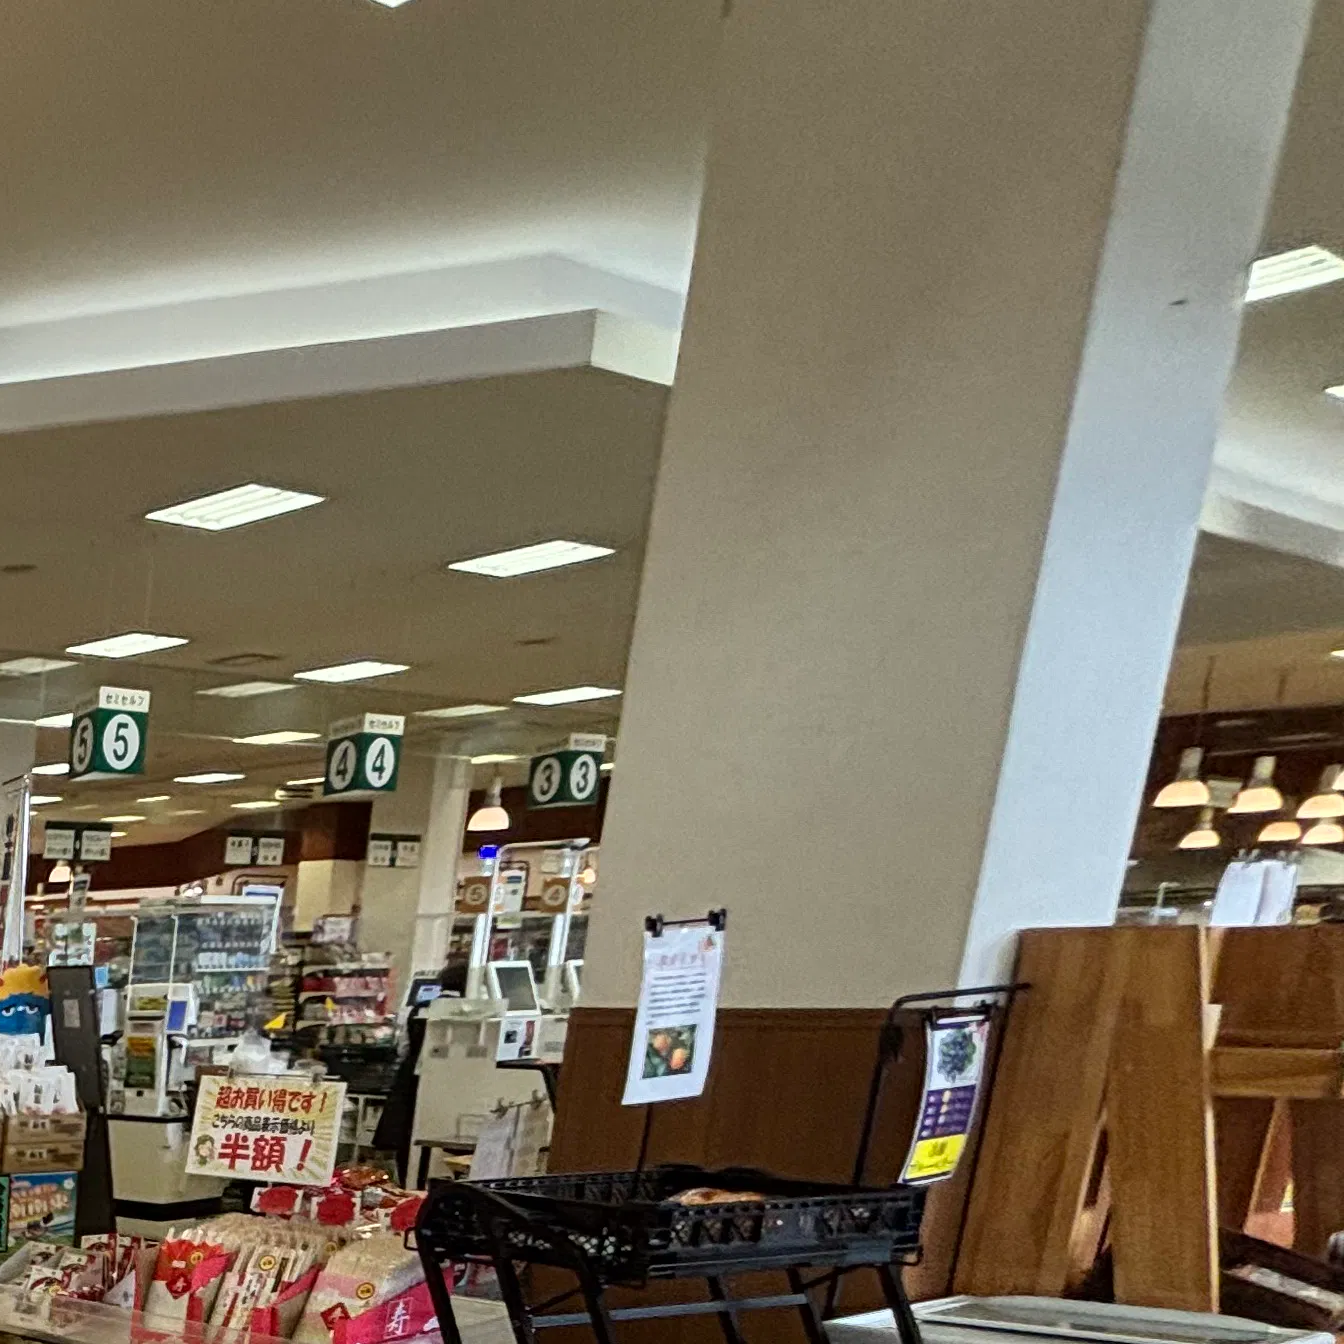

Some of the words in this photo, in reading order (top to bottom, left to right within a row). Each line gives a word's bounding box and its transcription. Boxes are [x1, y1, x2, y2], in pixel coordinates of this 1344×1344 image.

[78, 724, 89, 764] 5
[113, 722, 129, 762] 5
[336, 746, 349, 781] 4
[371, 744, 386, 781] 4
[540, 764, 554, 796] 3
[576, 761, 589, 795] 3
[215, 1085, 328, 1114] 超お買い得です！
[211, 1112, 316, 1137] こちらの商品表示価格より
[218, 1132, 313, 1174] 半額！
[389, 1302, 409, 1336] 寿
